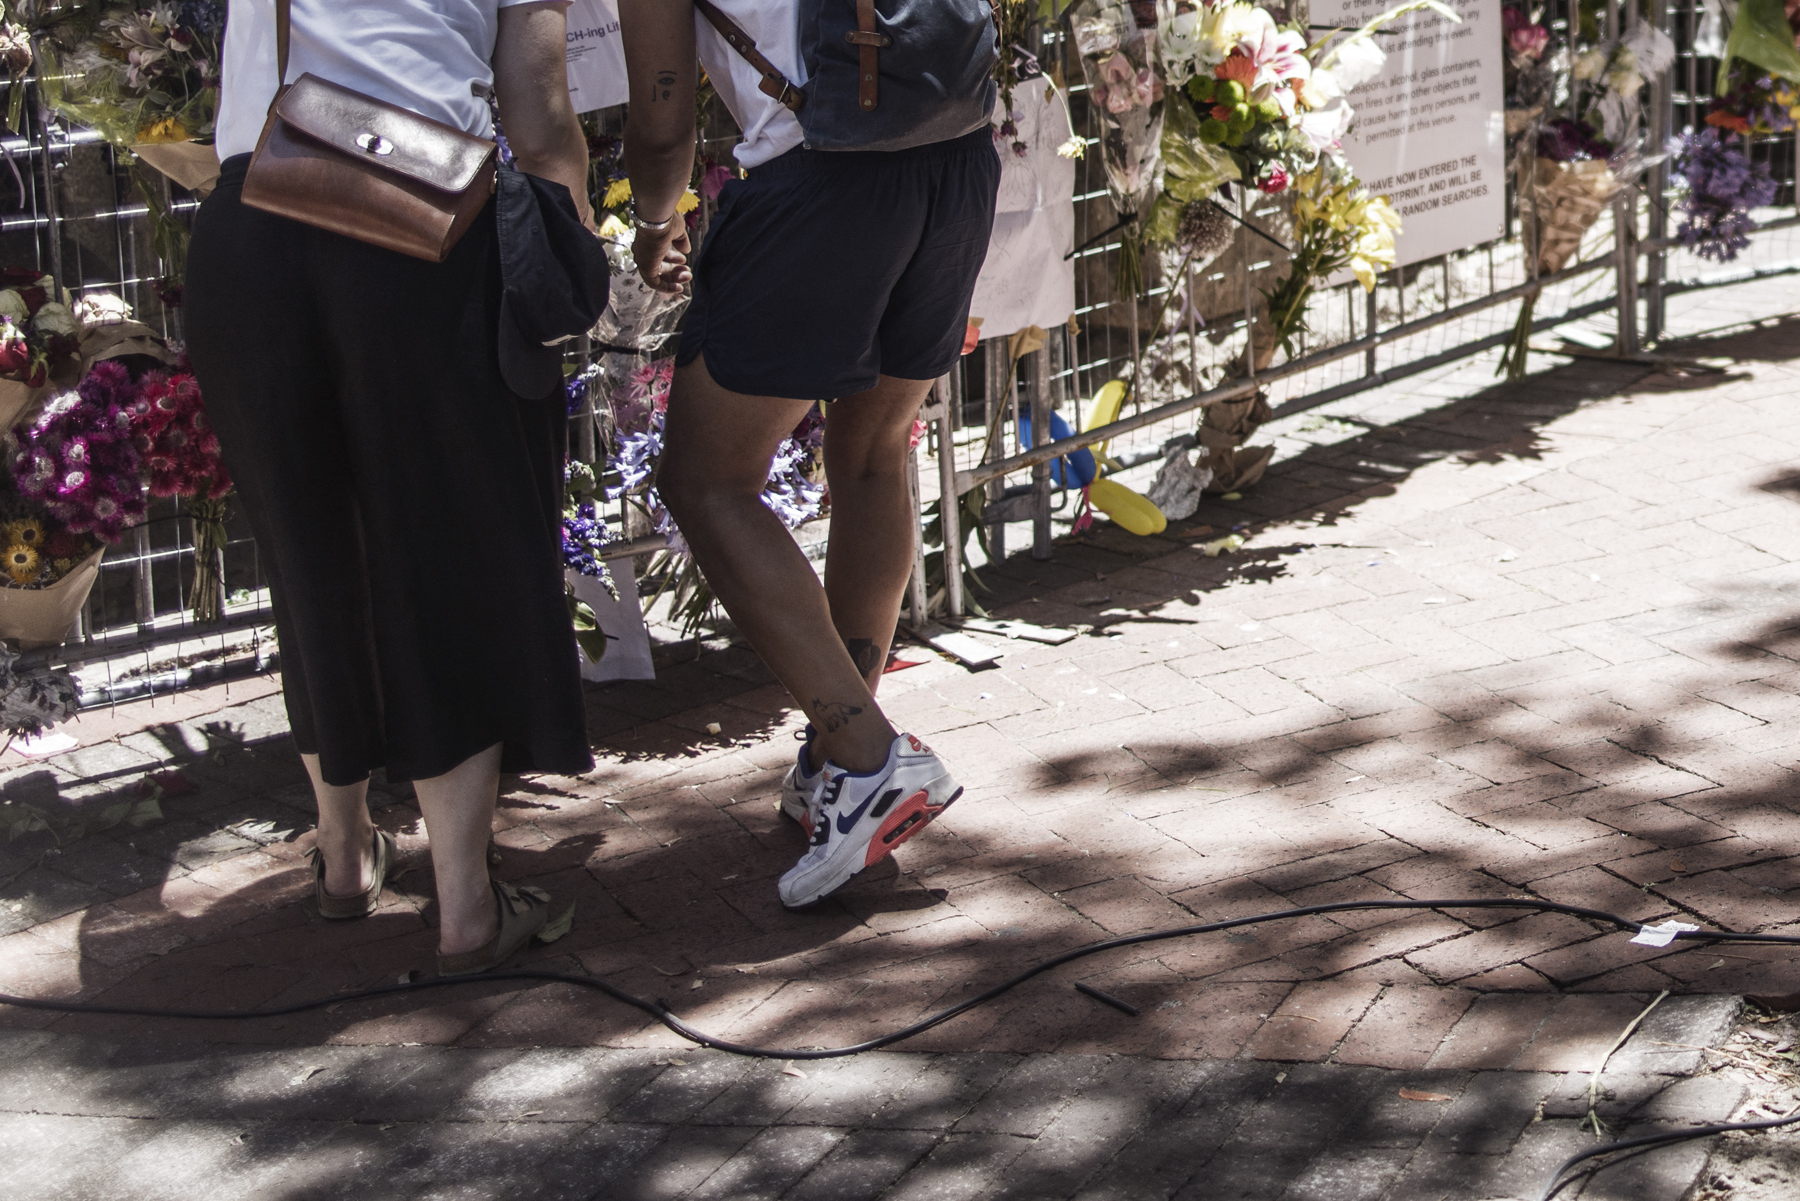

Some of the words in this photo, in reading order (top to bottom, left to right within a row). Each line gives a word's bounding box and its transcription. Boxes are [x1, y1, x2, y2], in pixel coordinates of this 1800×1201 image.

[1342, 1, 1352, 10] or
[1362, 12, 1374, 23] for
[1467, 10, 1480, 20] any
[566, 26, 606, 42] CH-ing
[606, 21, 620, 34] Lif
[1398, 34, 1434, 51] attending
[1436, 31, 1448, 42] this
[1451, 27, 1473, 40] event.
[1350, 80, 1388, 95] weapons,
[1390, 71, 1419, 87] alcohol,
[1421, 68, 1440, 82] glass
[1442, 58, 1482, 75] containers,
[1366, 97, 1382, 110] fires
[1384, 96, 1393, 104] or
[1396, 92, 1408, 103] any
[1411, 86, 1430, 98] other
[1432, 78, 1460, 94] objects
[1462, 74, 1477, 87] that
[1363, 114, 1386, 126] cause
[1388, 108, 1408, 122] harm
[1410, 106, 1418, 115] to
[1420, 103, 1433, 114] any
[1435, 97, 1467, 110] persons,
[1468, 92, 1480, 102] are
[1366, 124, 1406, 145] permitted
[1408, 124, 1415, 132] at
[1416, 117, 1430, 129] this
[1432, 114, 1456, 126] venue.
[1370, 176, 1394, 192] HAVE
[1396, 170, 1416, 186] NOW
[1418, 160, 1458, 180] ENTERED
[1460, 155, 1476, 168] THE
[1390, 185, 1426, 205] OTPRINT,
[1428, 179, 1446, 193] AND
[1448, 173, 1468, 188] WILL
[1470, 170, 1482, 182] BE
[1402, 197, 1440, 218] RANDOM
[1442, 184, 1490, 206] SEARCHES.
